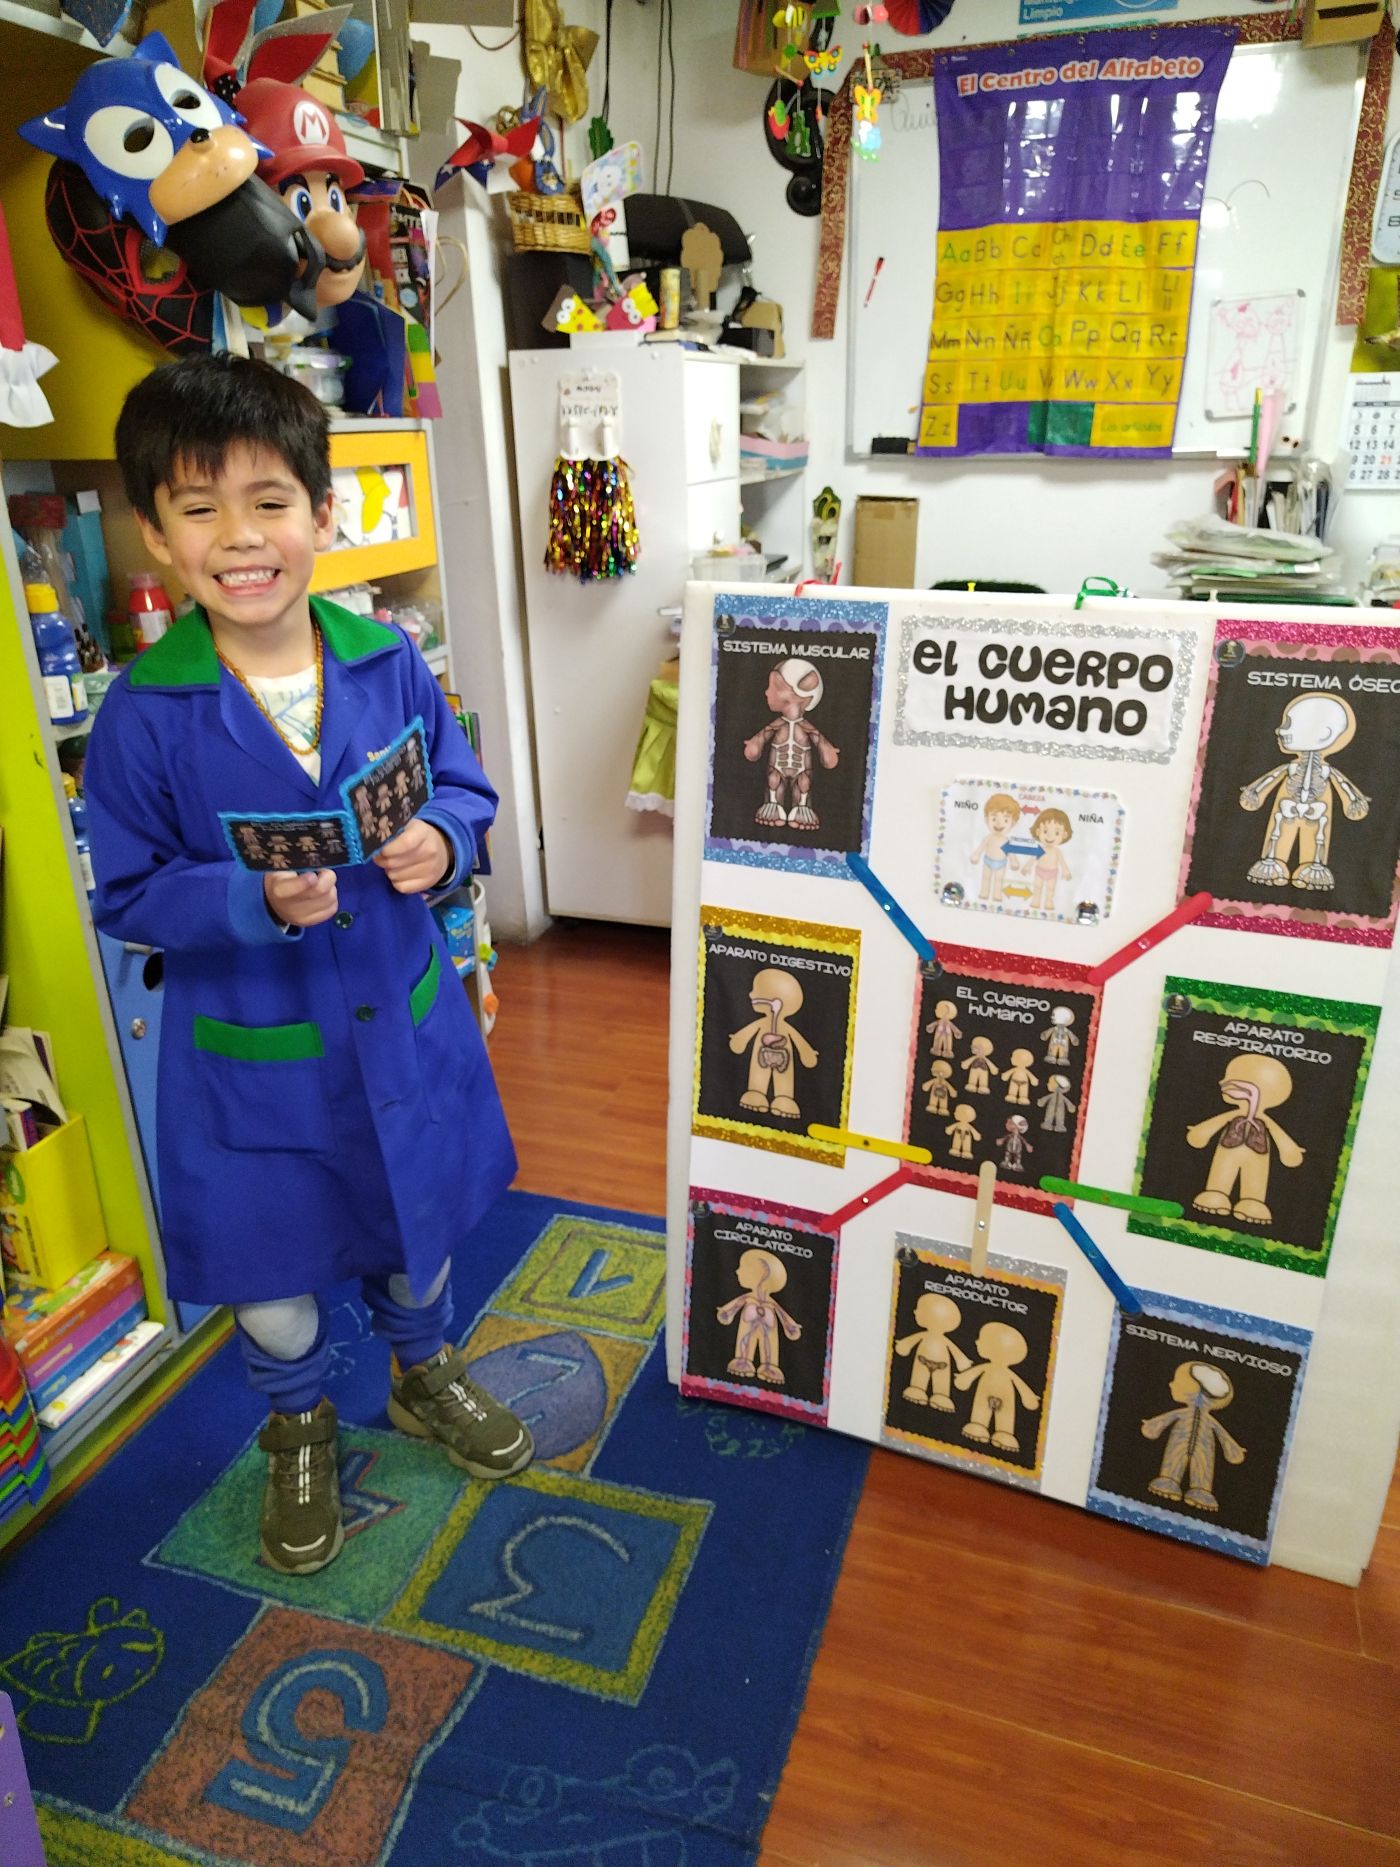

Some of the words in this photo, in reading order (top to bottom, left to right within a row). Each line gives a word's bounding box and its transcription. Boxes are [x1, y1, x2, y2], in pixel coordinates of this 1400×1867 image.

[957, 75, 977, 98] El
[980, 66, 1058, 92] Centro
[1061, 59, 1098, 82] del
[1099, 56, 1204, 80] Alfabeto
[301, 109, 327, 139] M
[1353, 424, 1360, 435] 5
[1371, 424, 1378, 435] 6
[1349, 440, 1360, 450] 12
[1366, 440, 1378, 450] 13
[1383, 440, 1395, 450] 14
[723, 640, 788, 655] SISTEMA
[791, 643, 870, 660] MUSCULAR
[1247, 671, 1342, 690] SISTEMA
[954, 800, 979, 811] NIÑO
[1078, 813, 1104, 824] NIÑA
[708, 943, 768, 962] APARATO
[769, 953, 851, 978] DIGESTIVO
[1223, 1021, 1305, 1045] APARATO
[1192, 1030, 1332, 1065] RESPIRATORIO
[735, 1221, 793, 1242] APARATO
[713, 1229, 814, 1259] CIRCULATORIO
[944, 1273, 1010, 1297] APARATO
[924, 1280, 1029, 1316] REPRODUCTOR
[1125, 1323, 1200, 1352] SISTEMA
[1203, 1343, 1293, 1377] NERVIOSO
